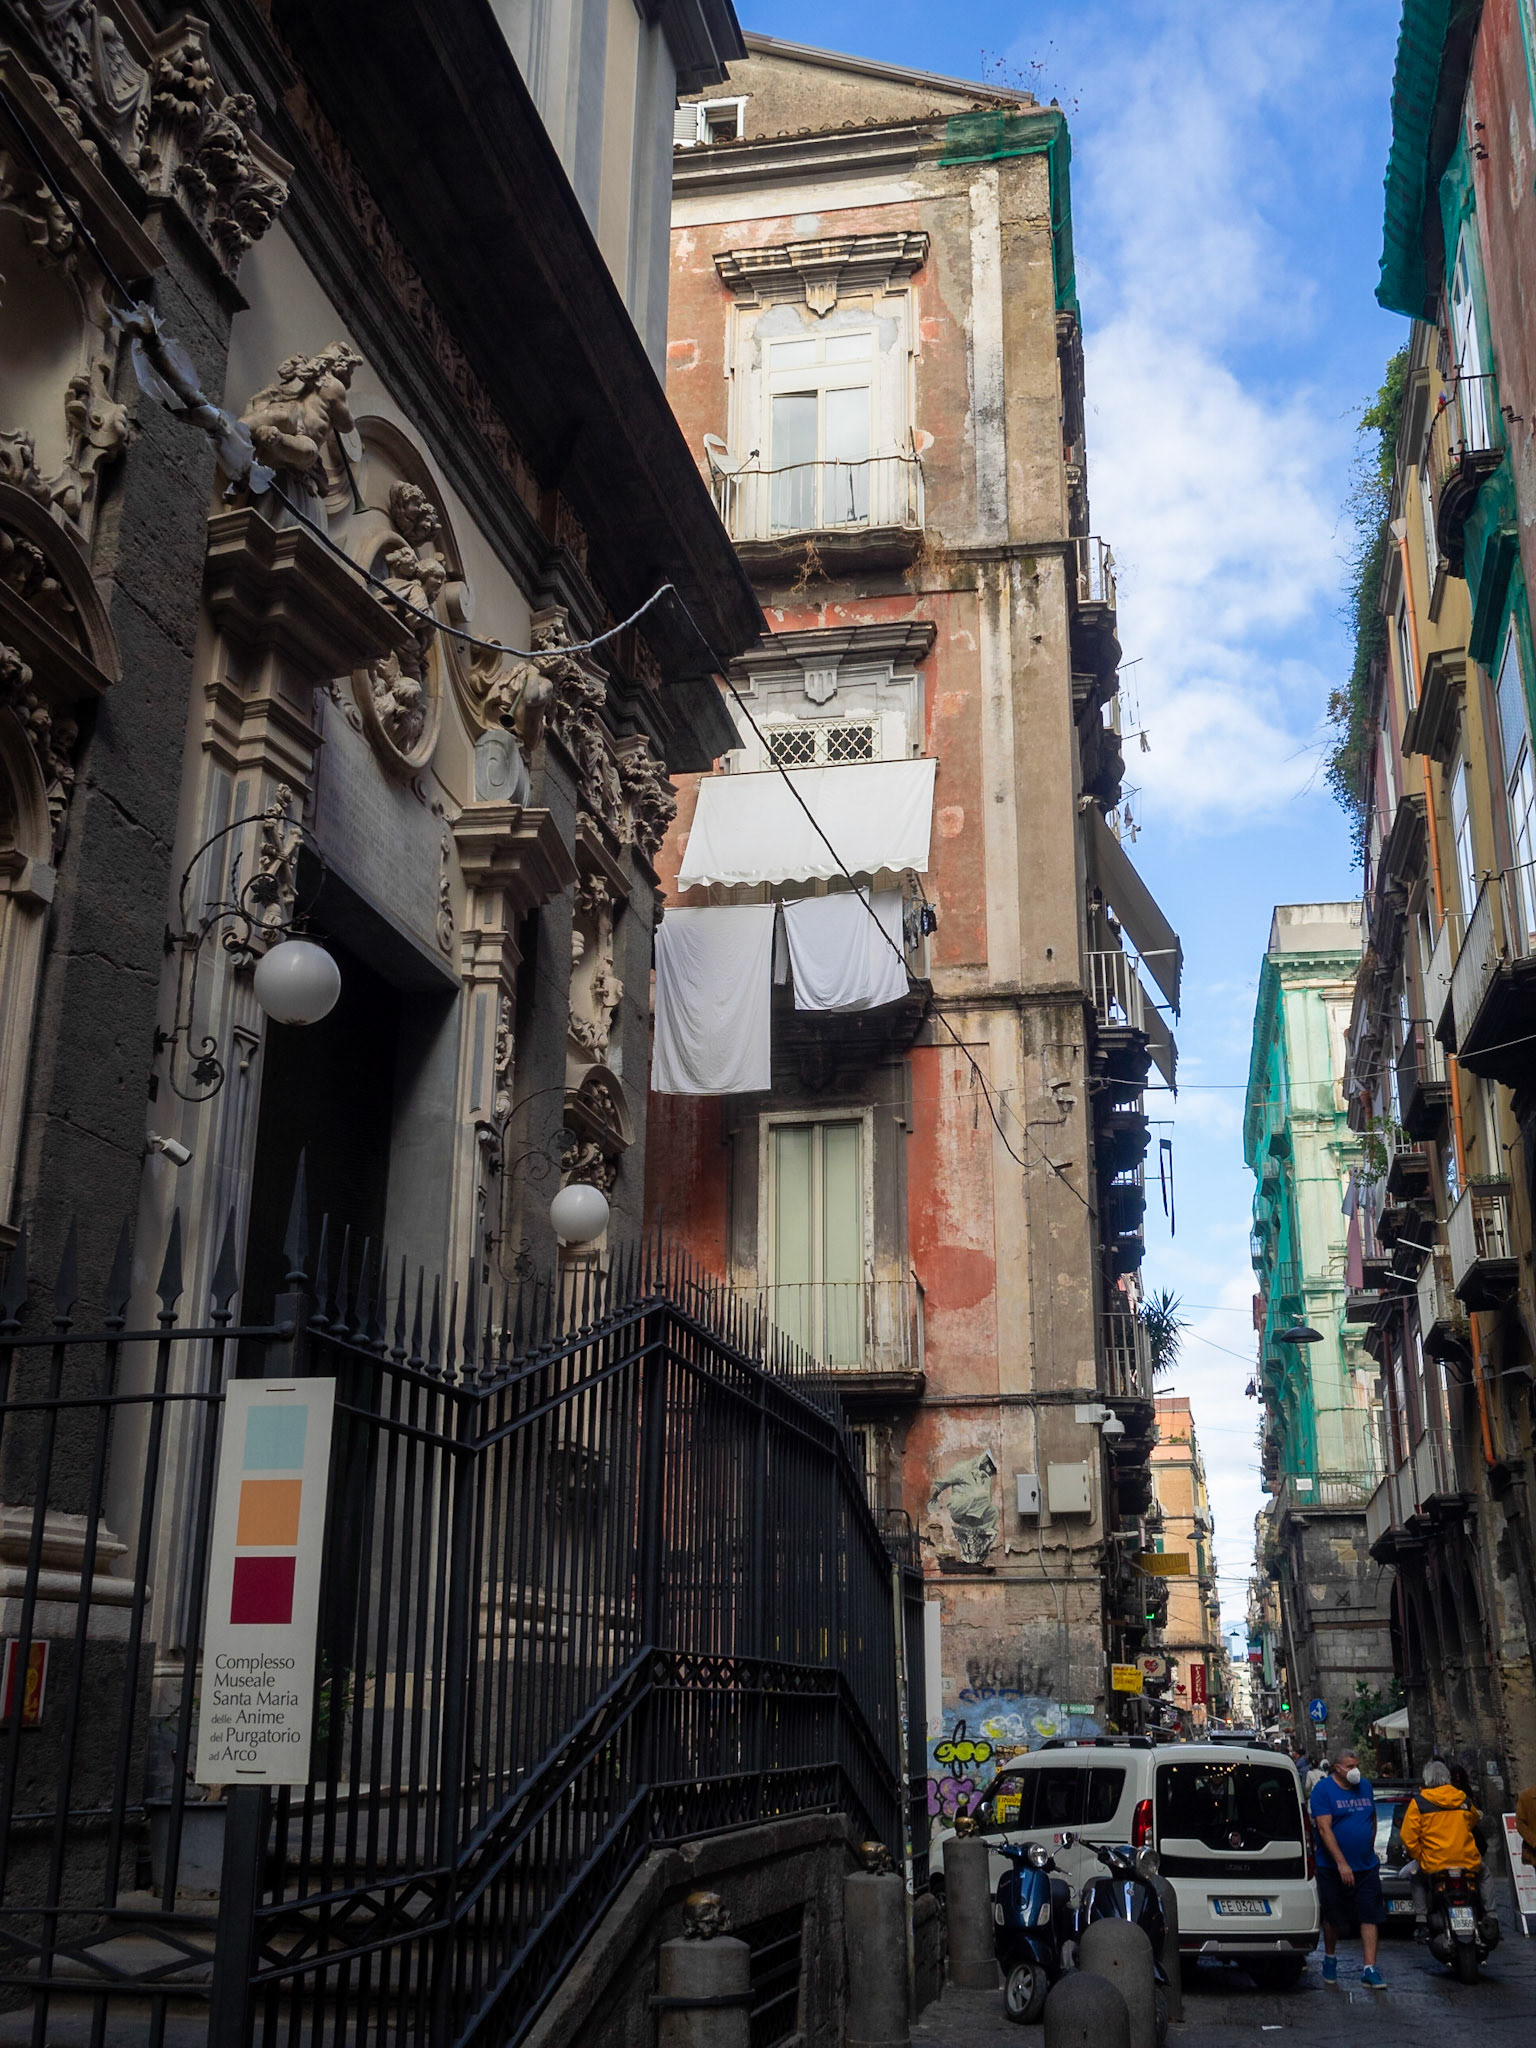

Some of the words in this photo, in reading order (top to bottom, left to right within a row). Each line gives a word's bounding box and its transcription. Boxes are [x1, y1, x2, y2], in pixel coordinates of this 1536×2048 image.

[216, 1653, 295, 1674] Complesso
[214, 1671, 276, 1688] Museale
[1195, 1666, 1203, 1702] PIZZERIA
[212, 1690, 252, 1706] Santa
[256, 1690, 299, 1706] Maria
[211, 1714, 232, 1724] delle
[235, 1709, 285, 1725] Anime
[209, 1732, 223, 1742] del
[226, 1727, 301, 1748] Purgatorio
[208, 1751, 220, 1761] ad
[221, 1745, 258, 1762] Arco
[1220, 1900, 1234, 1912] FE
